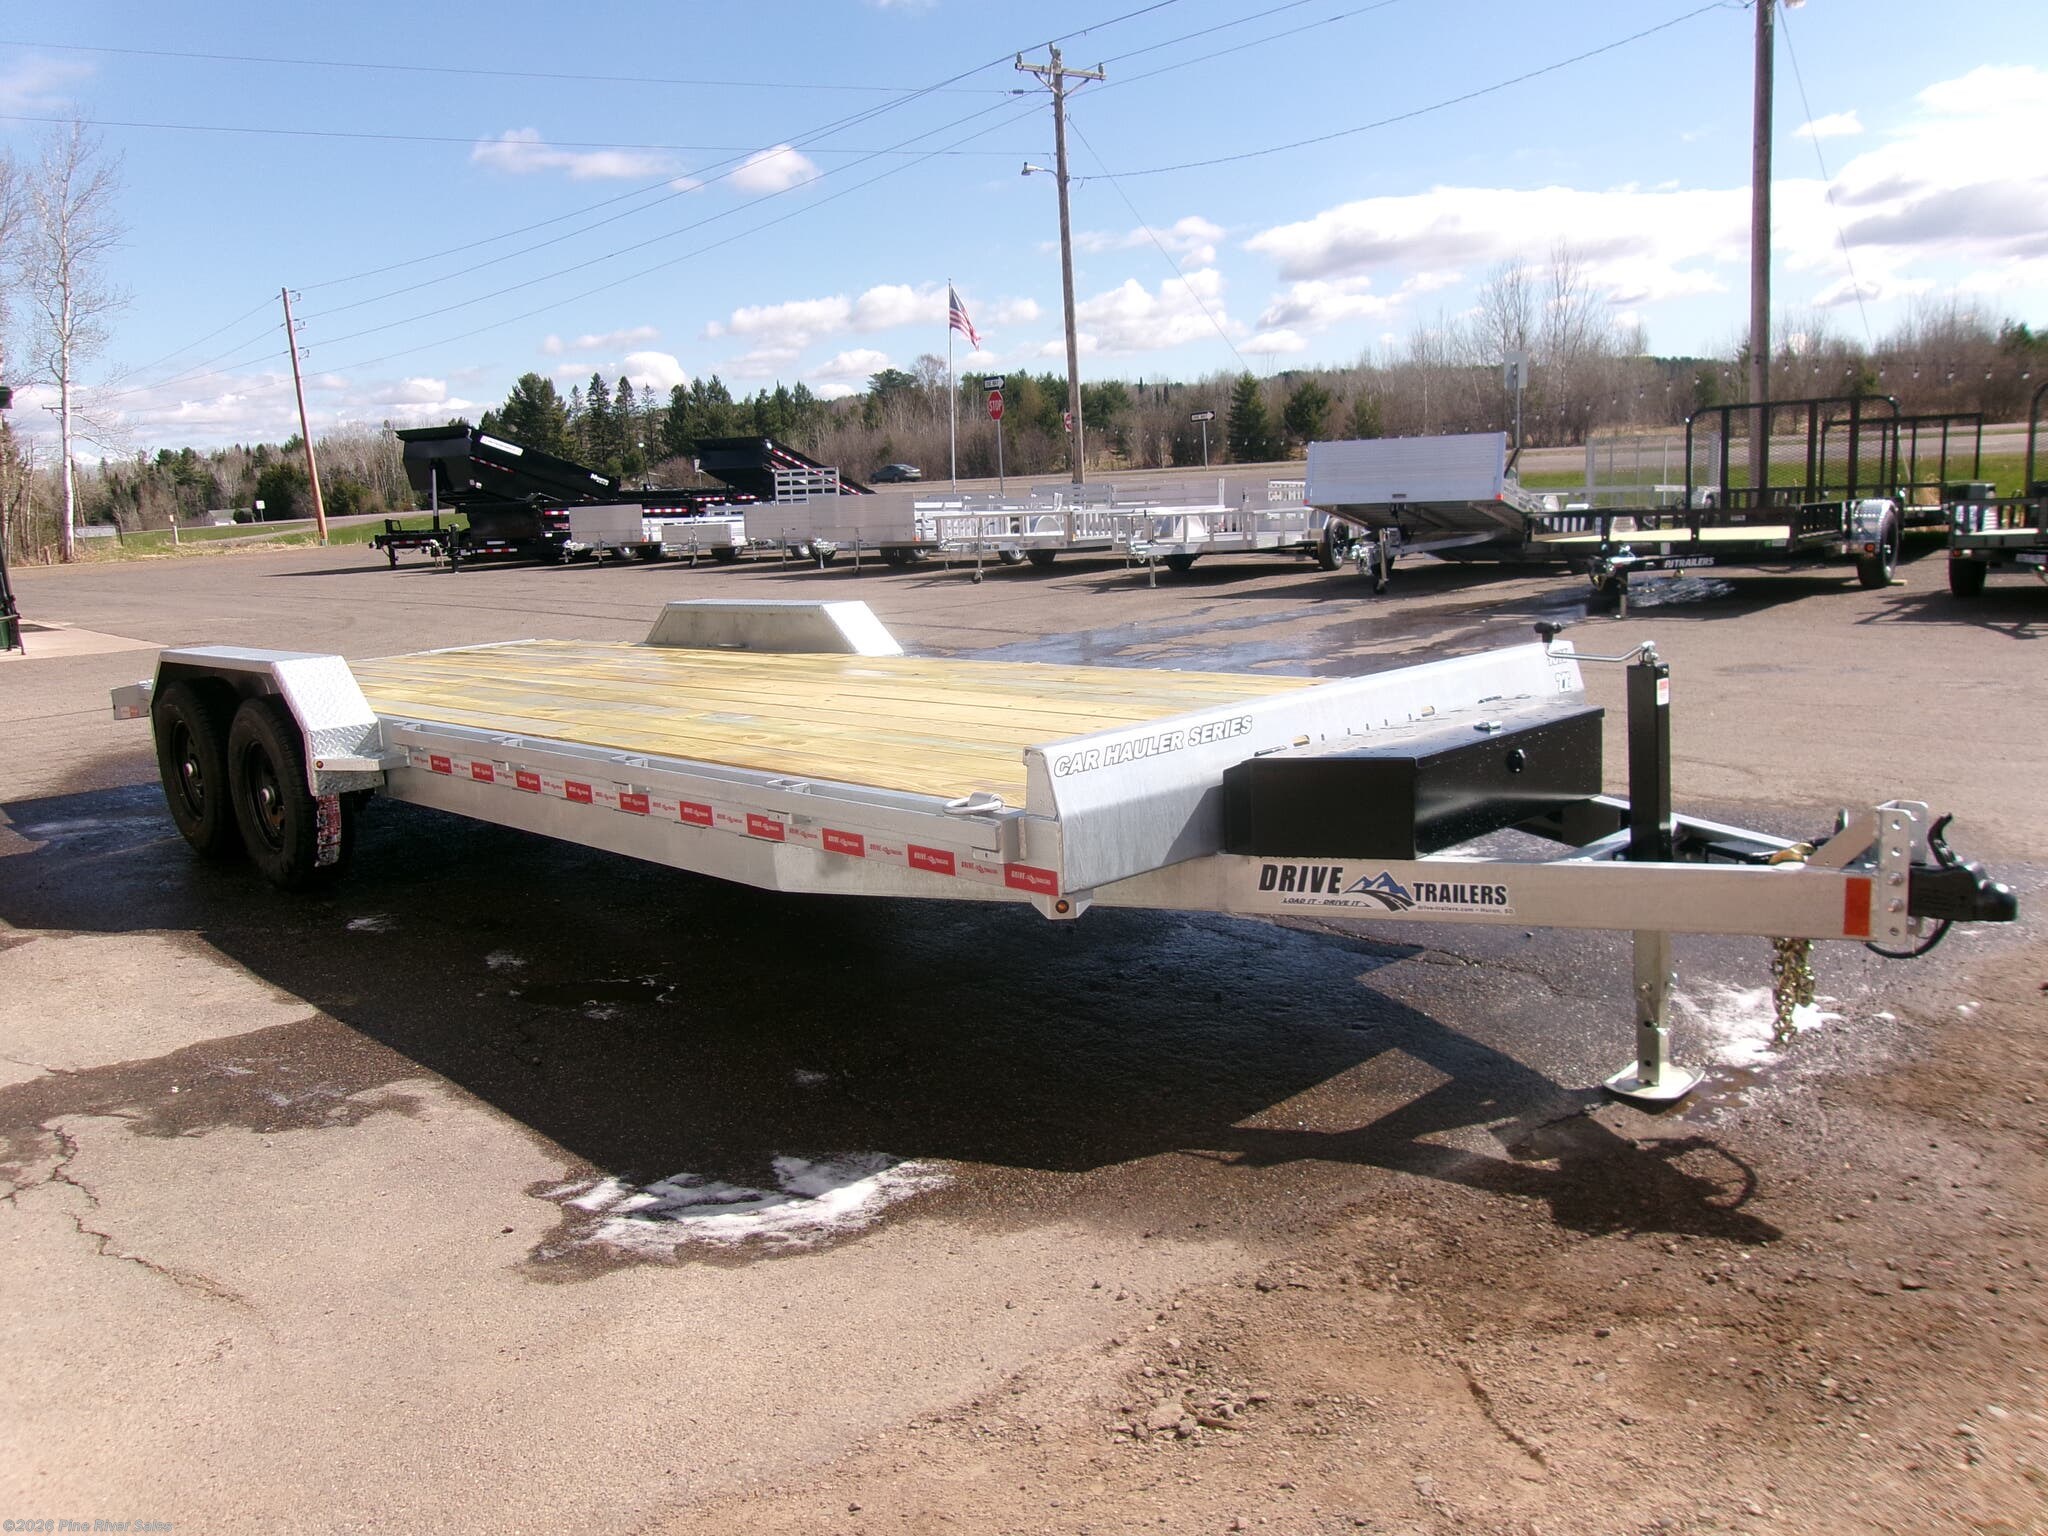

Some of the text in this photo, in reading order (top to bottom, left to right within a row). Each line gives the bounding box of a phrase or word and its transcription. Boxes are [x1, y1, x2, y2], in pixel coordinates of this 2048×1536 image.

[989, 400, 1002, 411] STOP
[1054, 715, 1253, 778] CAR HAULER SERIES
[1258, 864, 1507, 905] DRIVE TRAILERS
